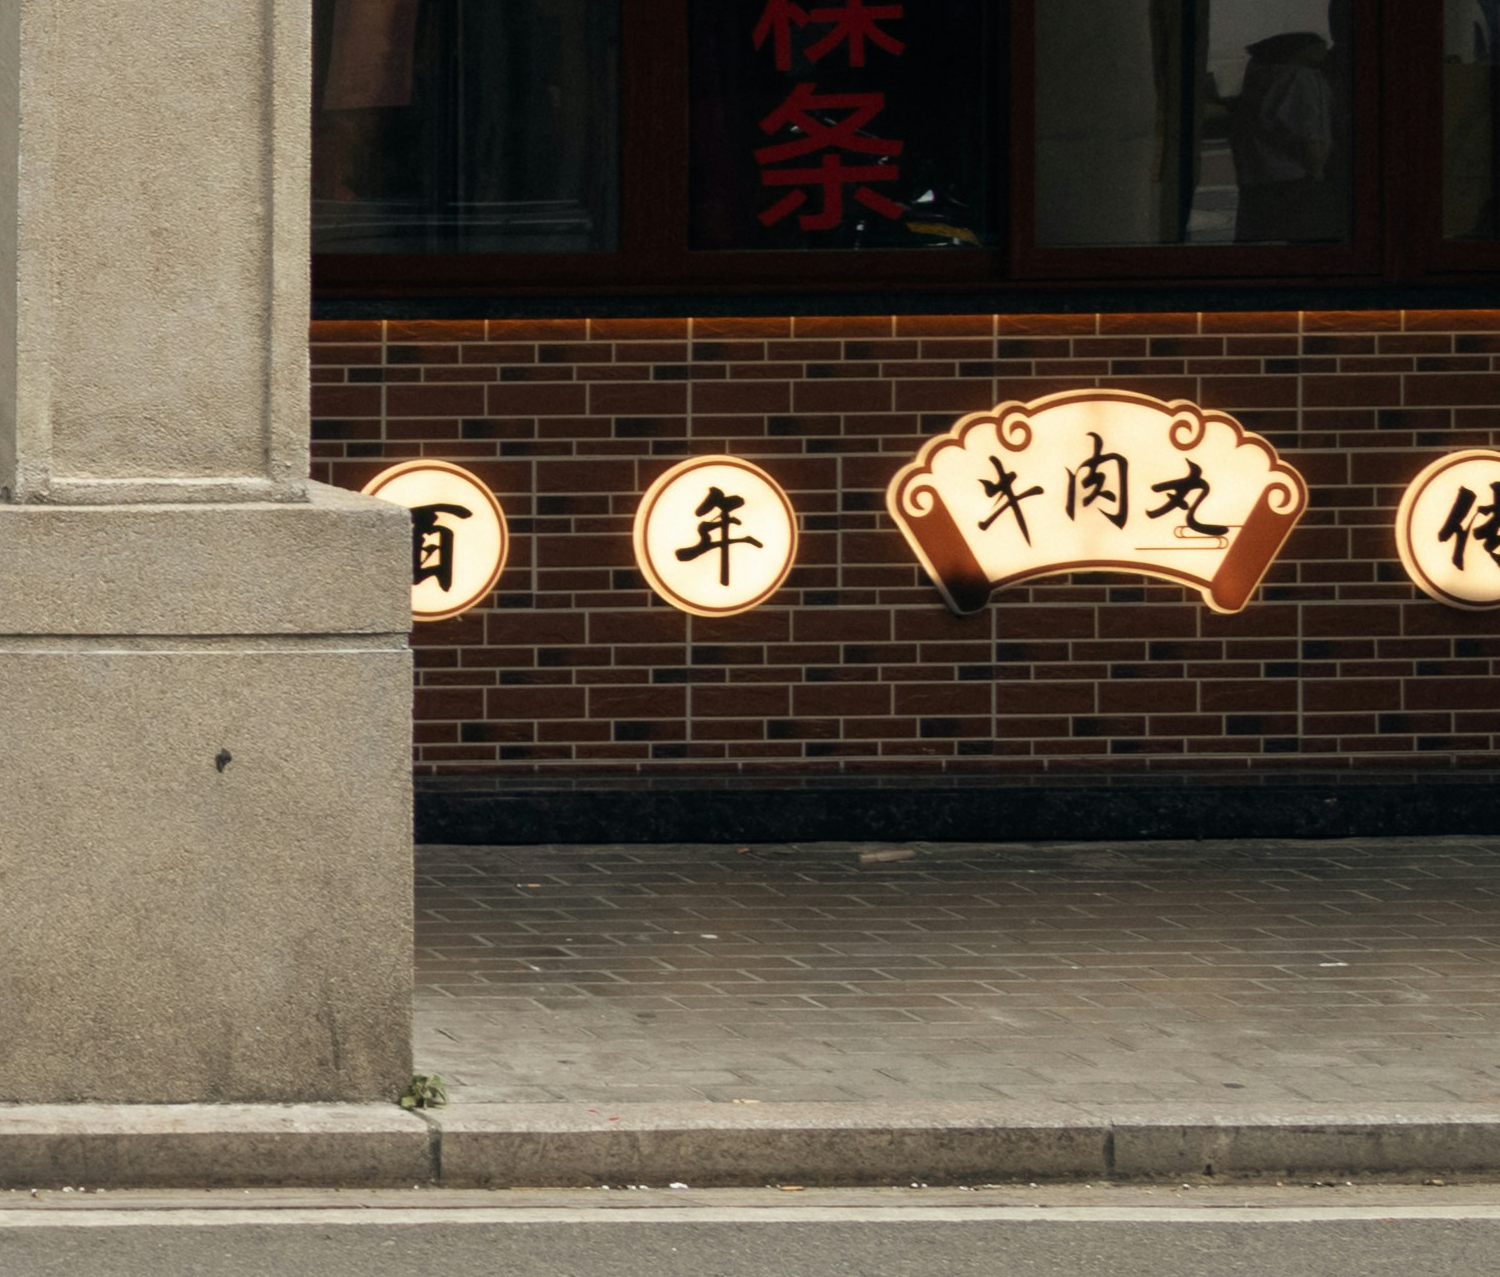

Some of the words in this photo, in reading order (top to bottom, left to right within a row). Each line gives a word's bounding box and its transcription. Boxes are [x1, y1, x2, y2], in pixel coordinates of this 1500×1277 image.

[674, 484, 765, 587] 年
[976, 431, 1232, 547] 牛肉丸
